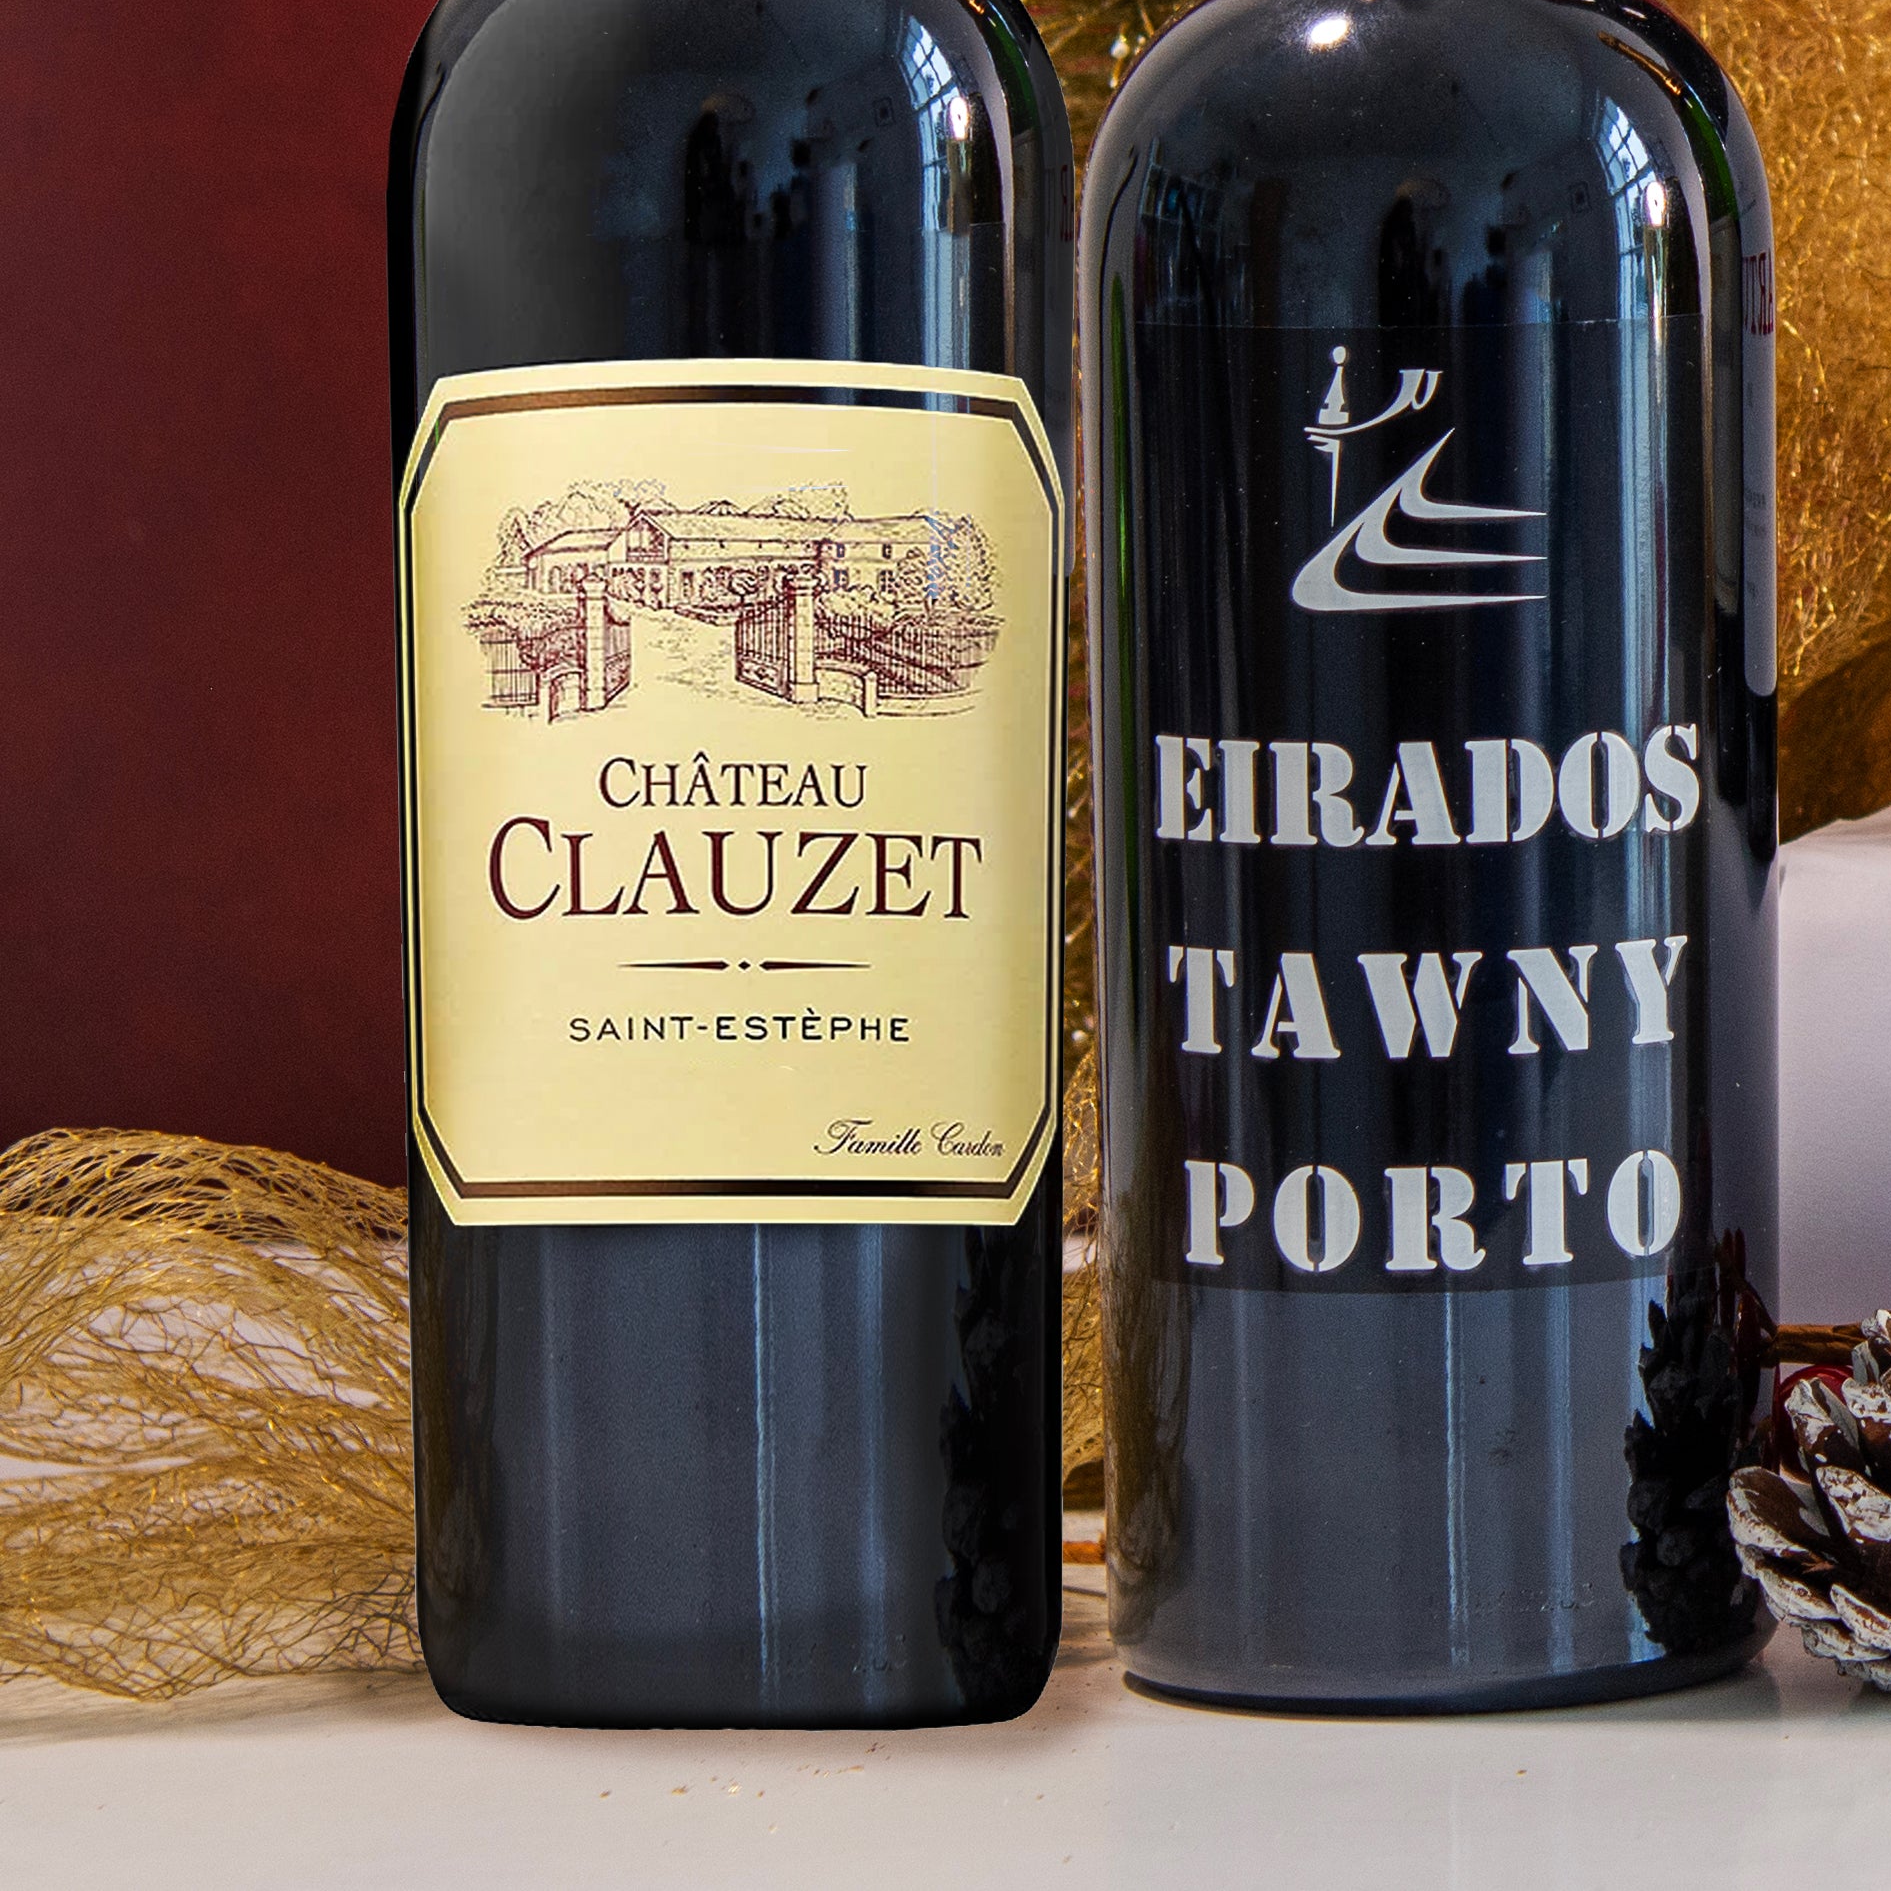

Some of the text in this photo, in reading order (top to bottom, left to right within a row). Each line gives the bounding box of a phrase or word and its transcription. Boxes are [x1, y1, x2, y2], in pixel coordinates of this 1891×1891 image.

[599, 751, 868, 809] CHÂTEAU
[1154, 723, 1701, 848] EIRADOS
[488, 815, 983, 921] CLAUZET
[568, 1007, 912, 1044] SAINT-ESTÈPHE
[1168, 934, 1687, 1059] TAWNY
[813, 1119, 922, 1155] Famille
[1183, 1148, 1682, 1274] PORTO
